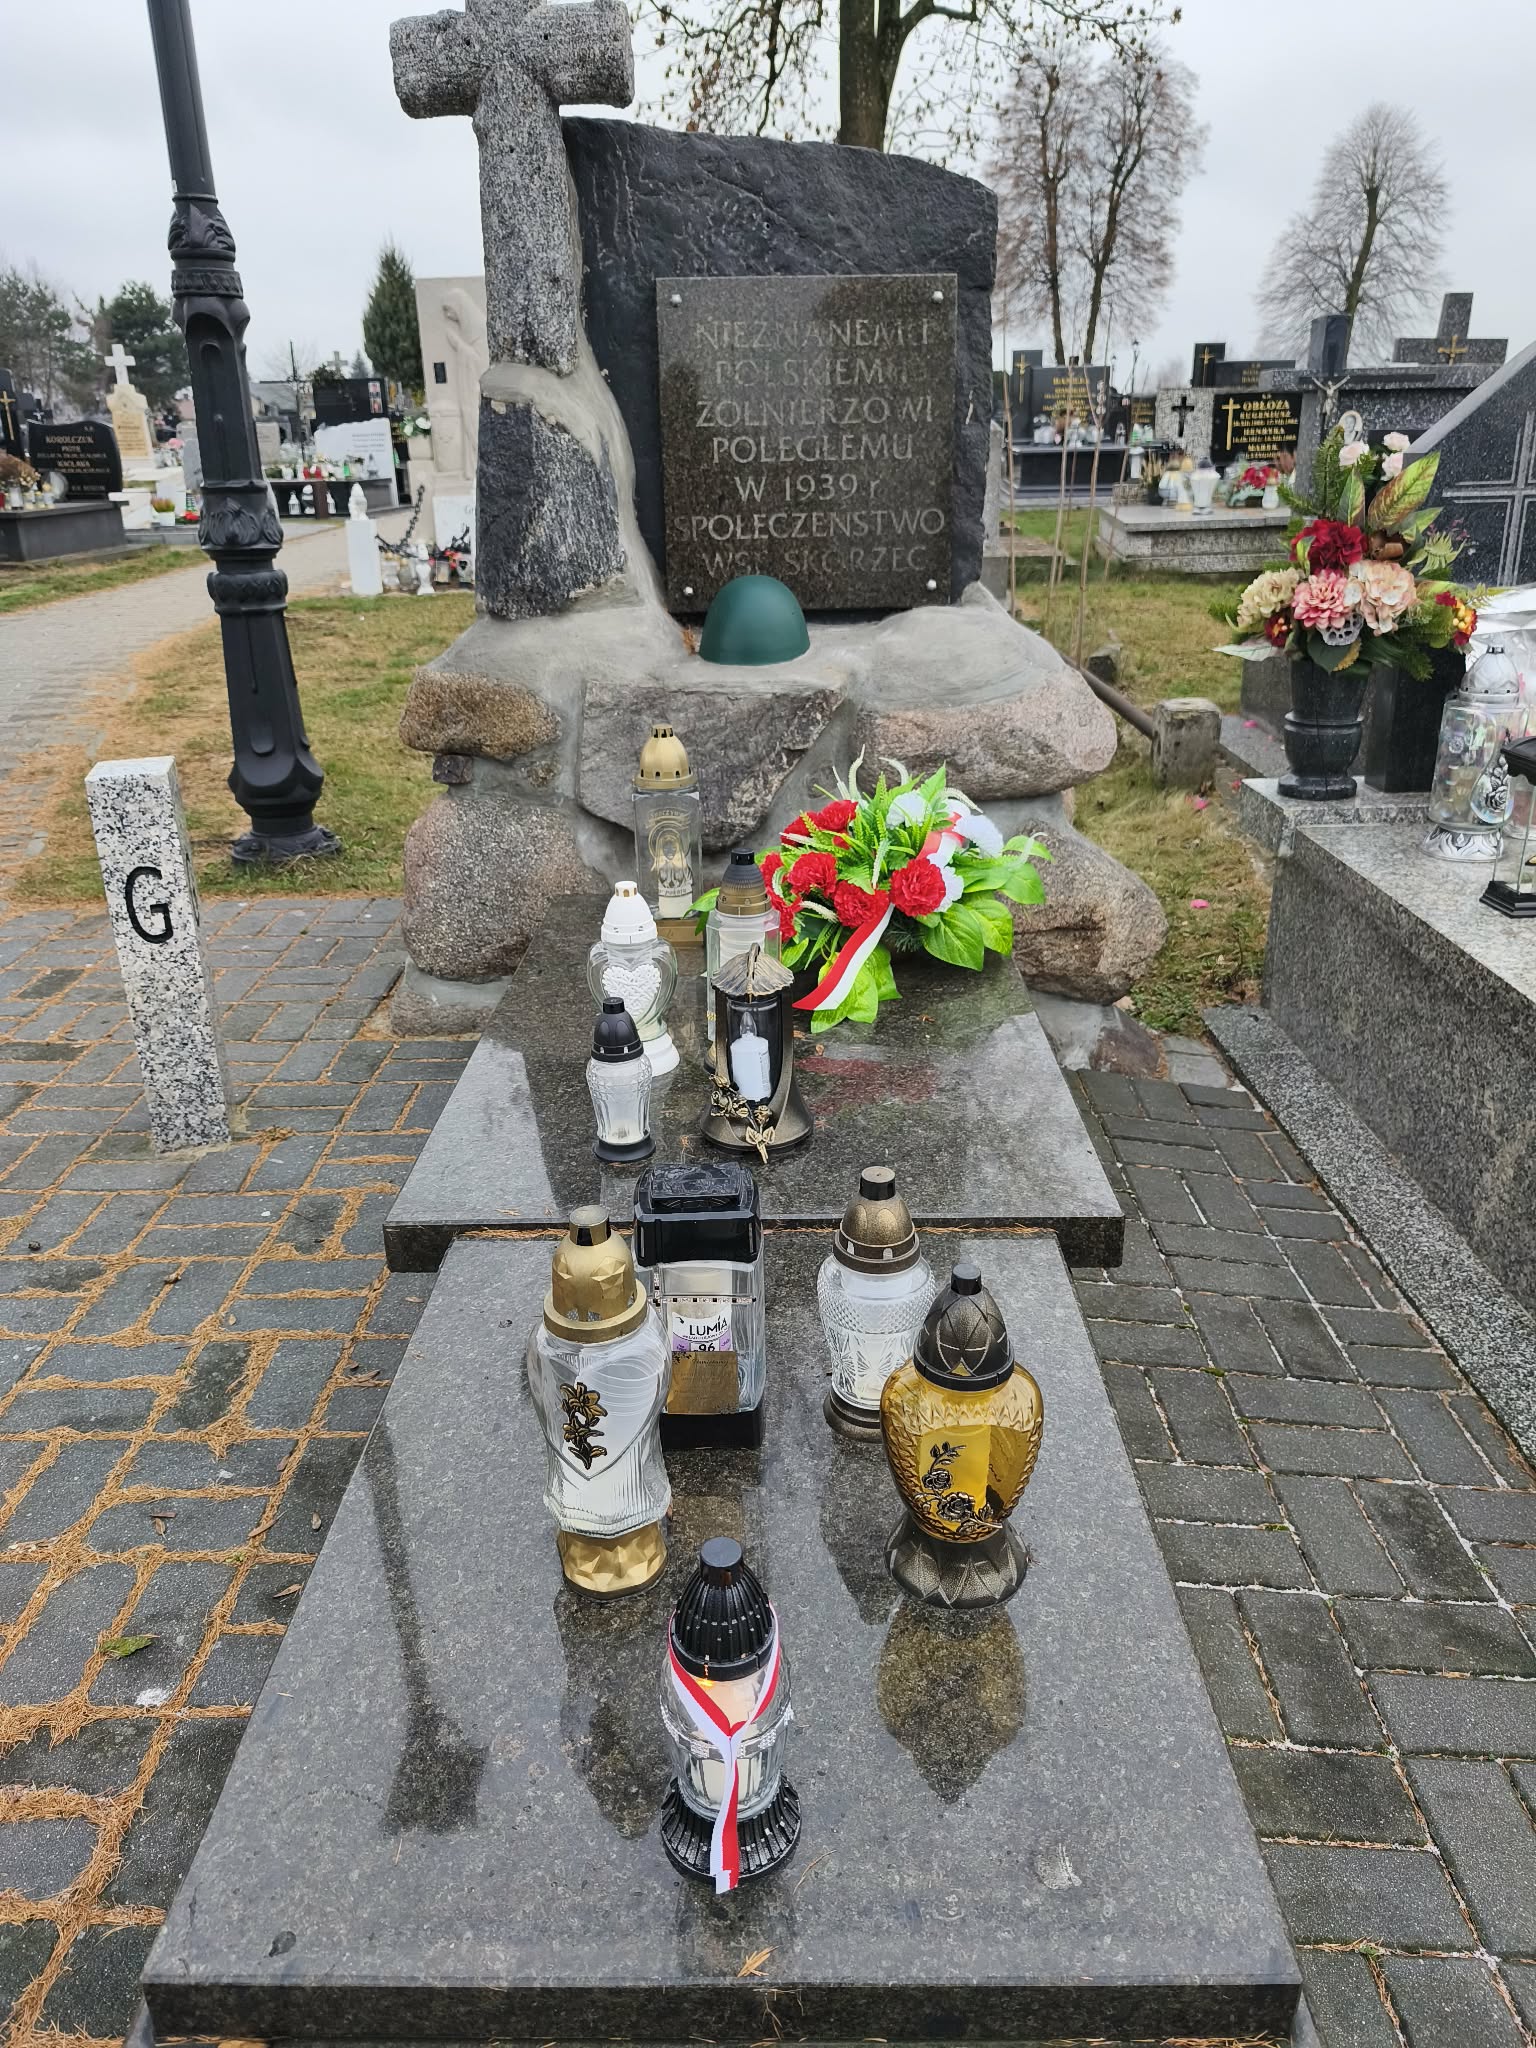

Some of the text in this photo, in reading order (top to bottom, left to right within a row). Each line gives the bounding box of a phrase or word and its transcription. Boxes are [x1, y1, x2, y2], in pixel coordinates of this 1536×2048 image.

[734, 475, 767, 503] W
[784, 473, 858, 502] 1939
[125, 866, 173, 944] G
